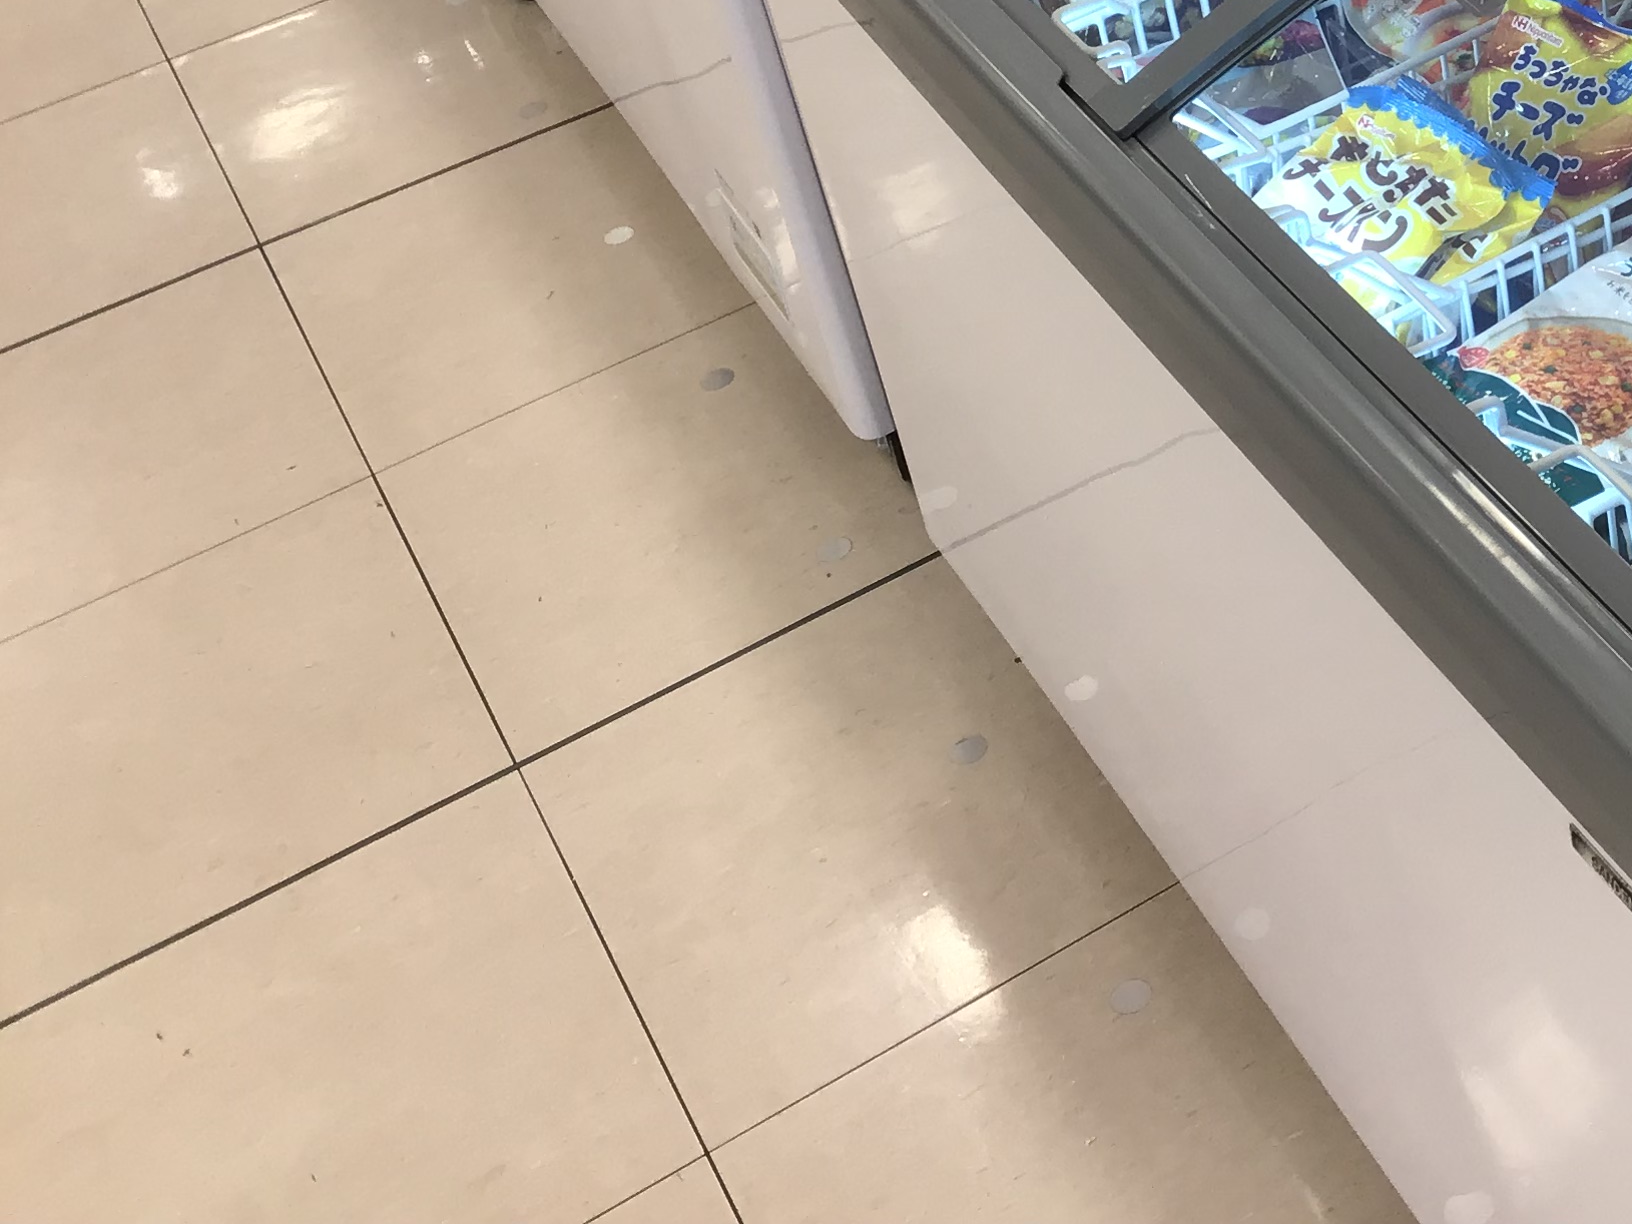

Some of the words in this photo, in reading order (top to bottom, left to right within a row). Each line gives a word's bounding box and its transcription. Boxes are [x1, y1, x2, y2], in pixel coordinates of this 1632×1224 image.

[1512, 15, 1528, 31] NH
[1513, 44, 1609, 106] ちっちゃな
[1492, 80, 1586, 142] チーズ
